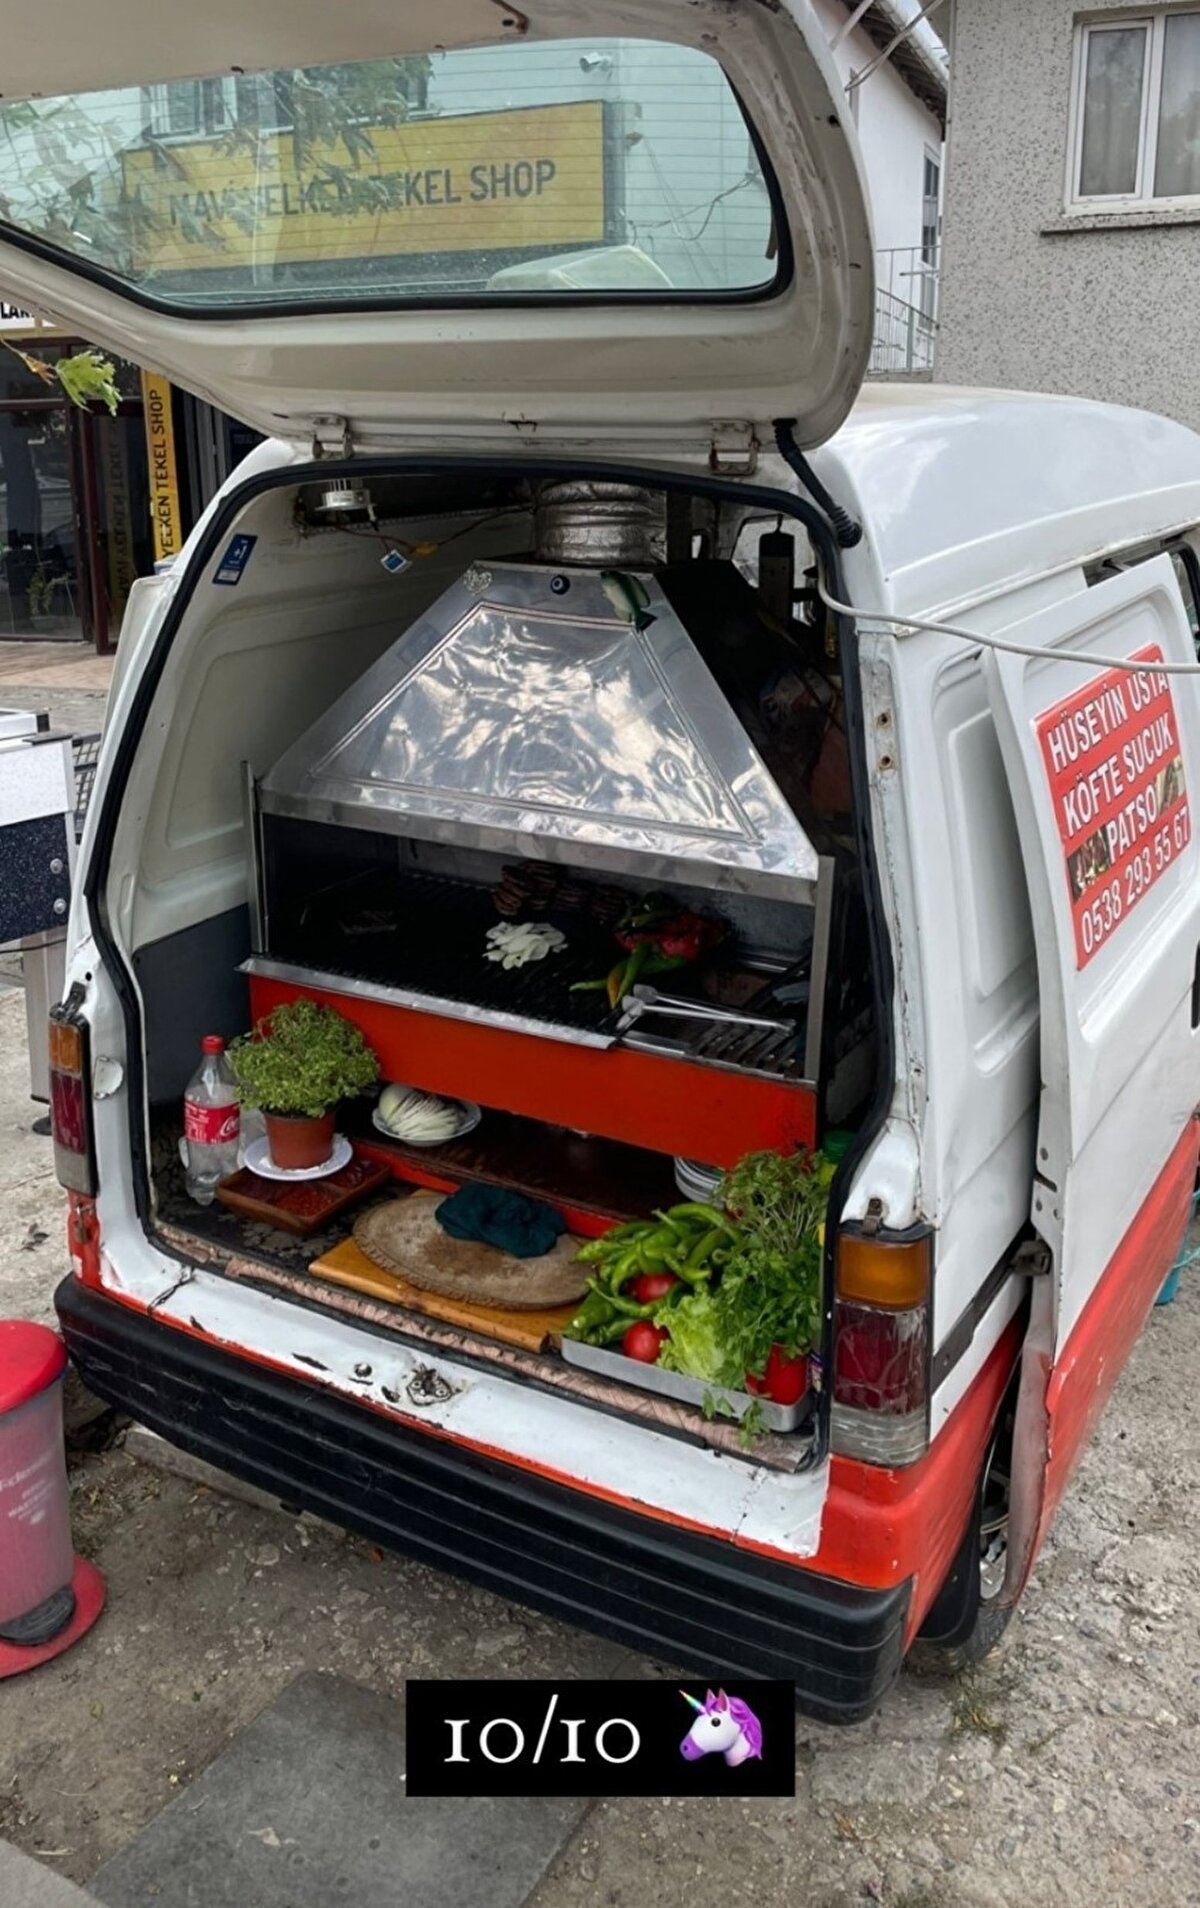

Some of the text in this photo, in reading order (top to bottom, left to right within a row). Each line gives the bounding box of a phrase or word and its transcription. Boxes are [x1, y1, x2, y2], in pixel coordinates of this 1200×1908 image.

[469, 158, 556, 201] SHOP
[149, 389, 166, 435] SHOP
[153, 441, 169, 490] TEKEL
[1047, 682, 1128, 774] HÜSEYİN
[1062, 712, 1174, 837] KÖFTE SUCUK
[1106, 784, 1158, 864] PATSO
[1081, 805, 1189, 954] 0538 293 55 67
